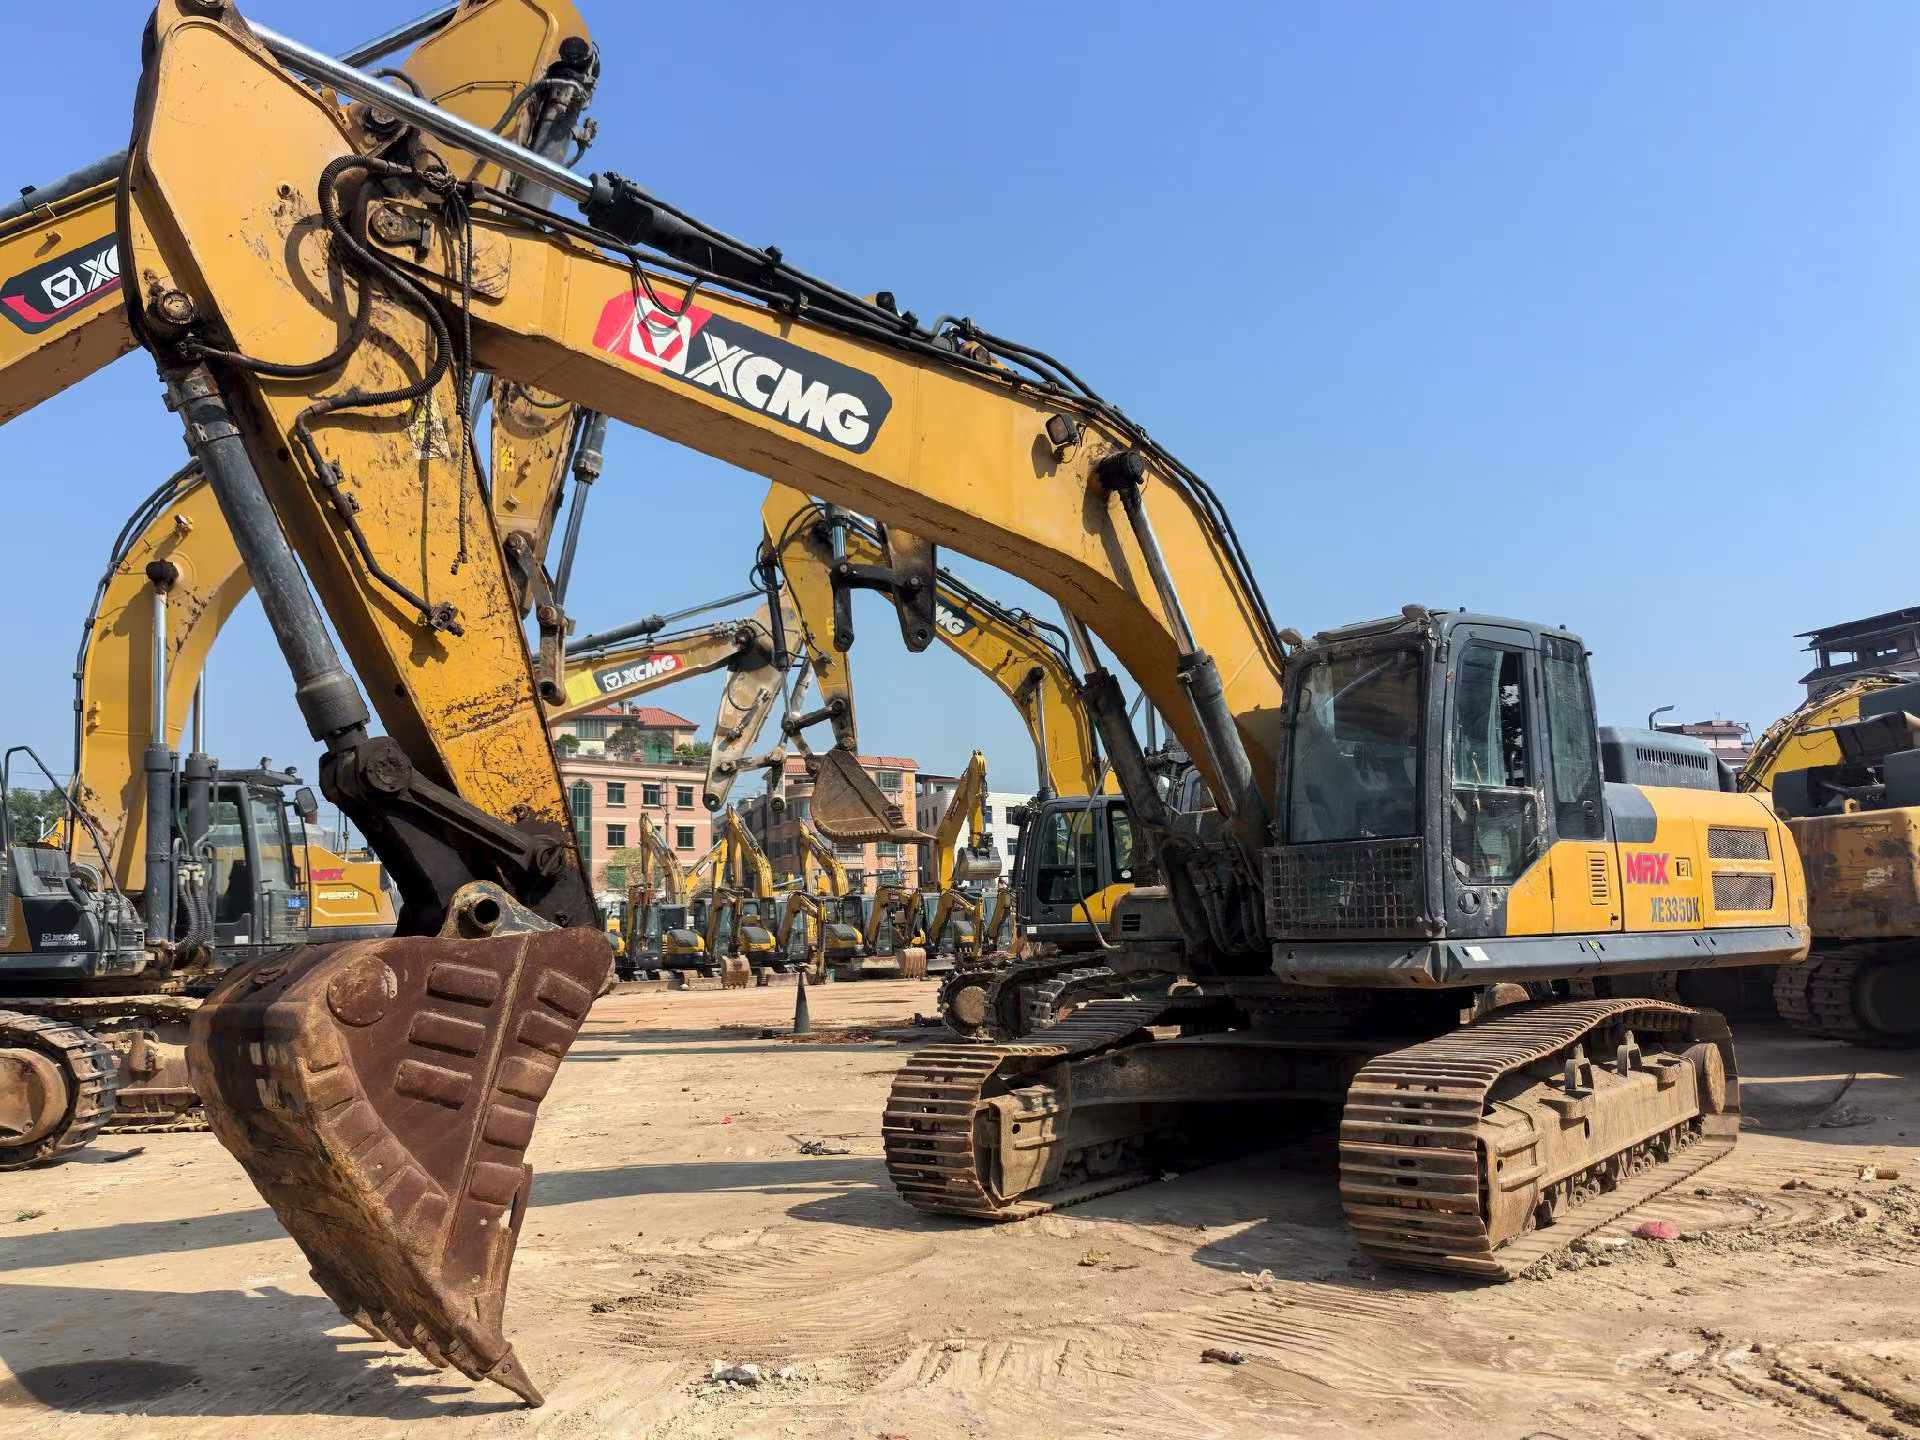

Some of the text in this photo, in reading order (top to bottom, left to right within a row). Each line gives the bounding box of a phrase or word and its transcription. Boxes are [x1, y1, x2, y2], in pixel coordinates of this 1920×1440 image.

[684, 331, 870, 445] XCMG
[622, 654, 676, 686] XCMG
[1626, 853, 1669, 884] MAX
[1651, 896, 1700, 923] XE335DK
